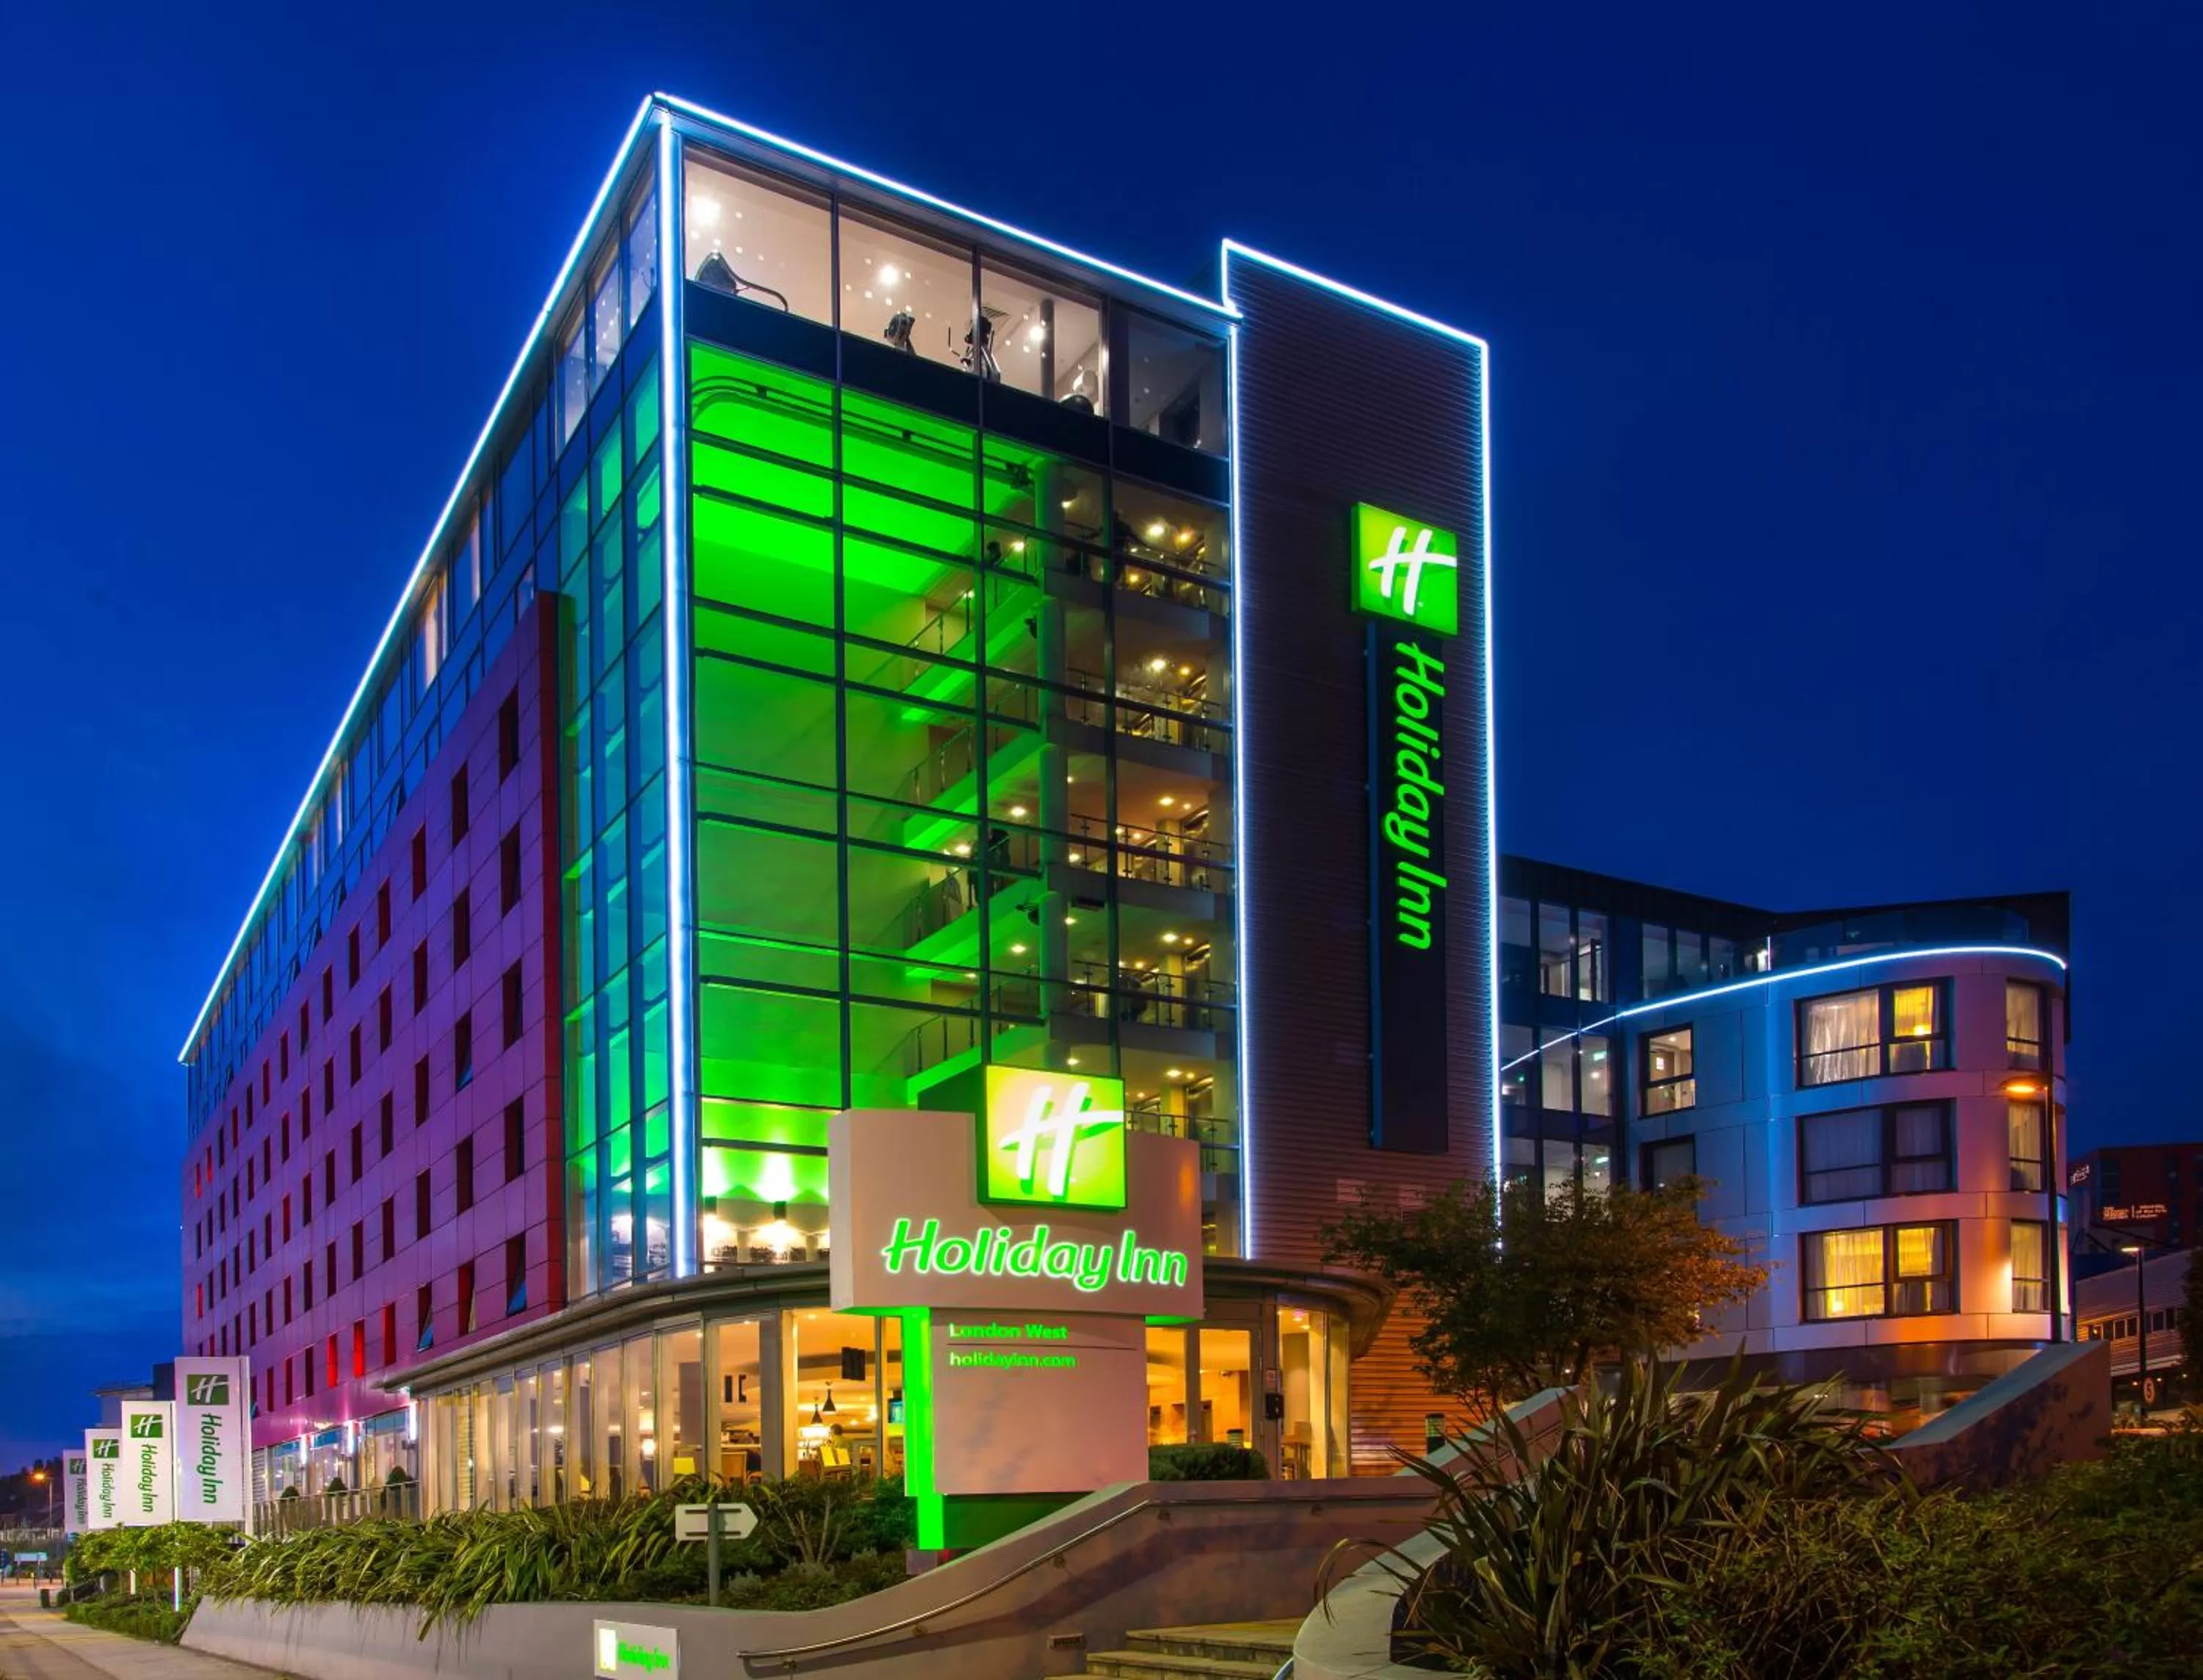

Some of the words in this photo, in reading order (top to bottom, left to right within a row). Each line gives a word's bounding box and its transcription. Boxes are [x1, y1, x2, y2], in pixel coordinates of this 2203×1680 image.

[1369, 526, 1457, 616] H
[1383, 642, 1445, 858] Holiday
[1397, 861, 1447, 949] Inn
[998, 1082, 1124, 1197] H
[882, 1217, 1115, 1292] Holiday
[1117, 1229, 1188, 1286] Inn
[949, 1322, 1021, 1339] London
[1024, 1324, 1068, 1339] West
[949, 1351, 1077, 1370] holidayinn.com
[137, 1444, 158, 1493] Holiday
[196, 1413, 223, 1476] Holiday
[99, 1463, 115, 1502] Holiday
[142, 1493, 158, 1513] Inn
[203, 1477, 223, 1504] Inn
[103, 1502, 116, 1518] Inn
